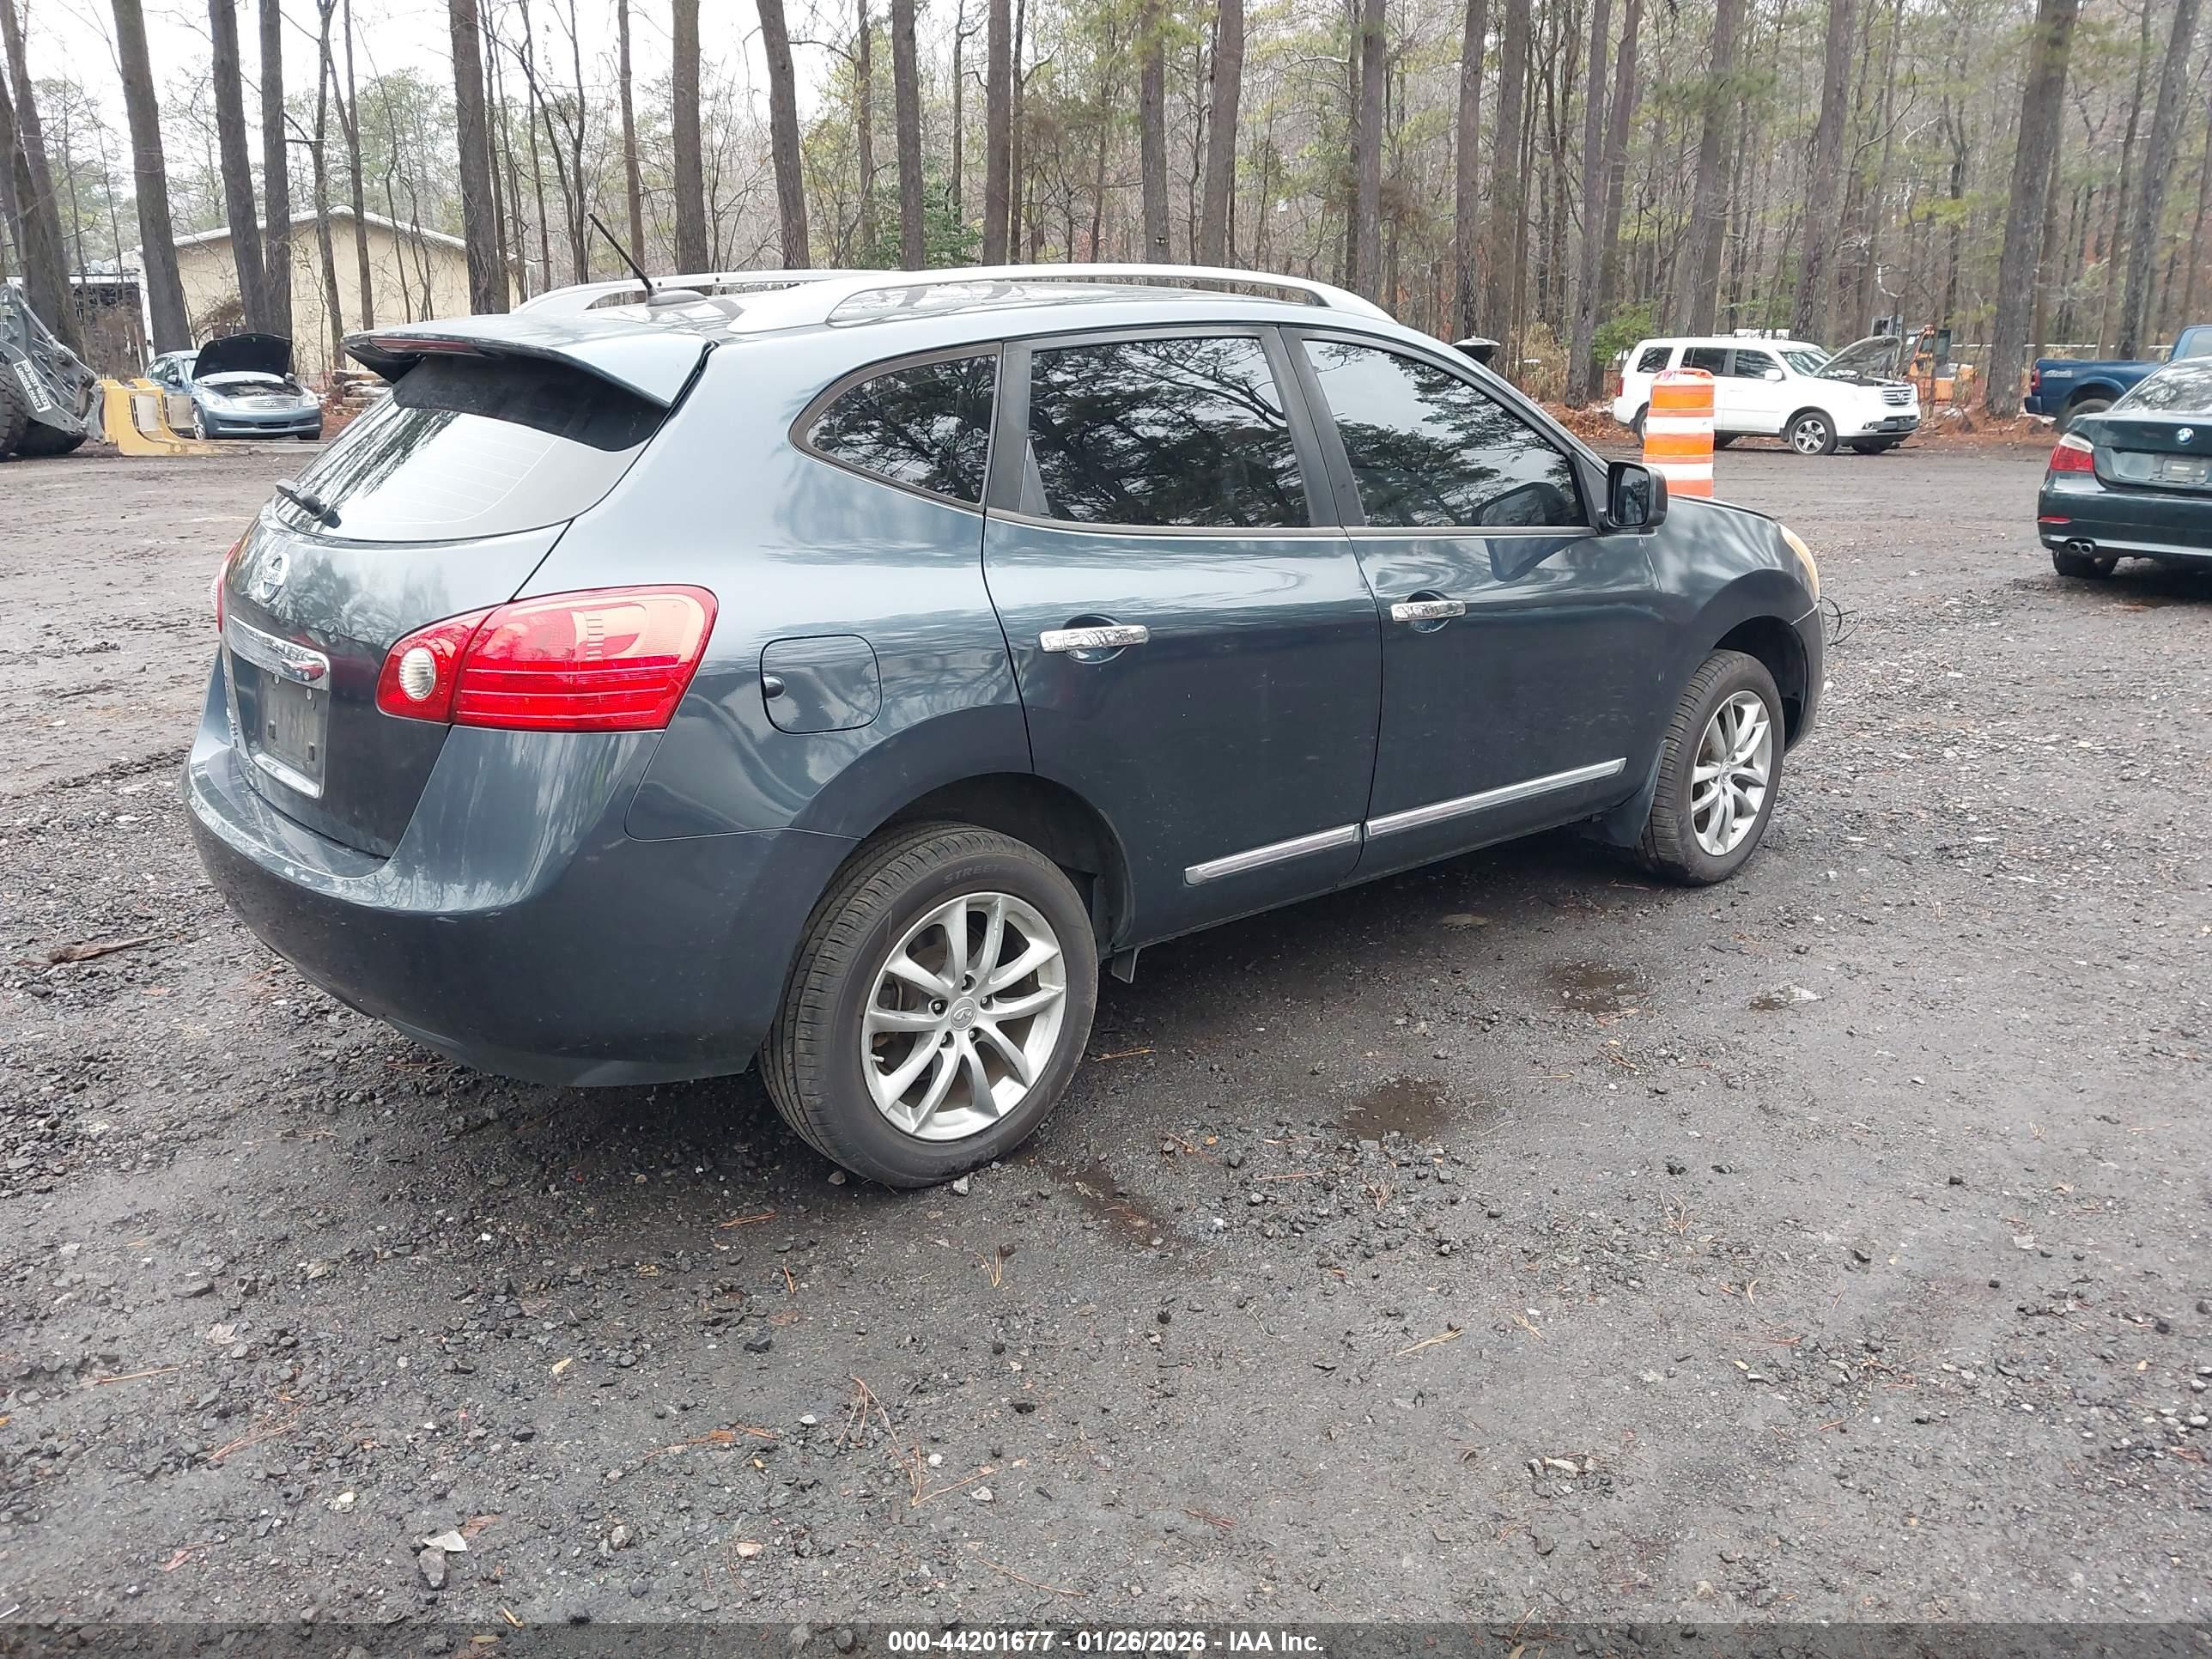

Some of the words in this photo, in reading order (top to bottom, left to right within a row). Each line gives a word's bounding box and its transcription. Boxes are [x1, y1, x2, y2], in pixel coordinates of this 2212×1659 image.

[17, 368, 32, 390] UNDER
[29, 390, 42, 406] MAST
[27, 373, 39, 386] NOT
[36, 387, 51, 408] WALK
